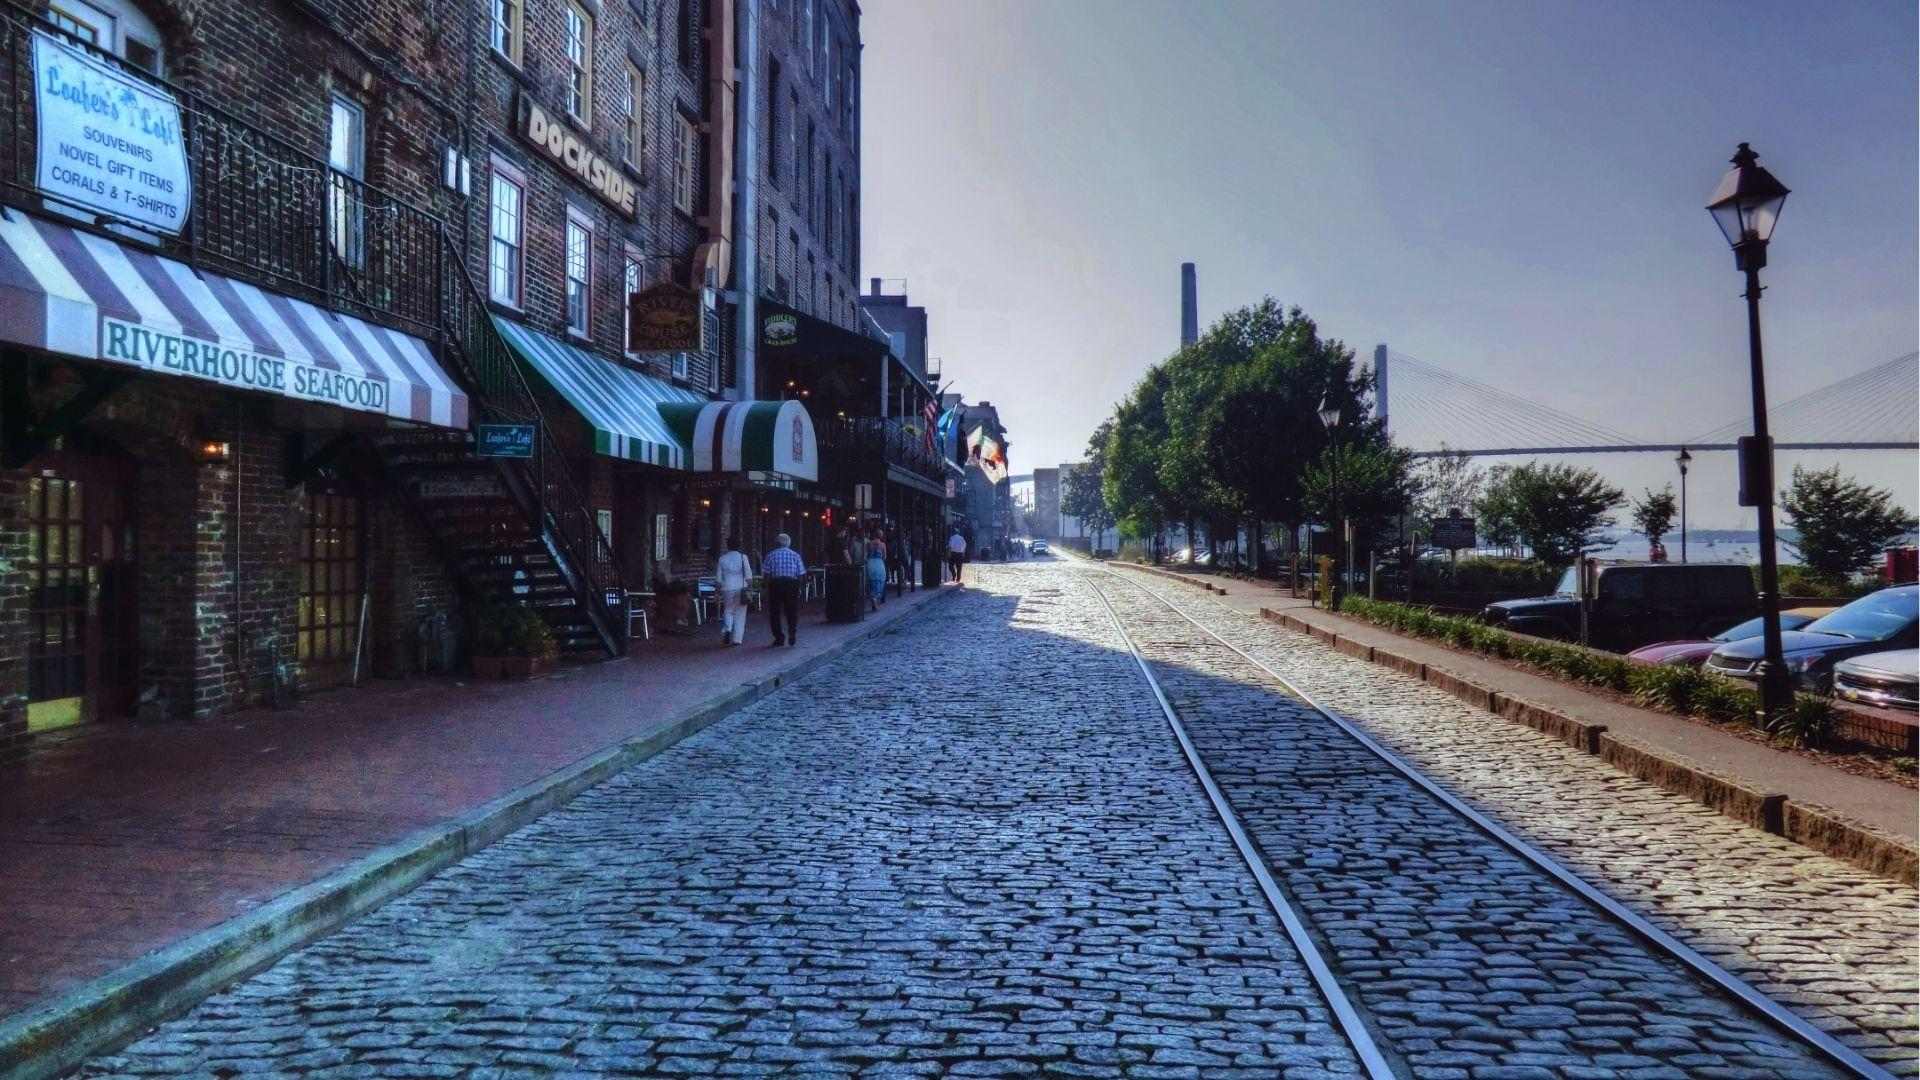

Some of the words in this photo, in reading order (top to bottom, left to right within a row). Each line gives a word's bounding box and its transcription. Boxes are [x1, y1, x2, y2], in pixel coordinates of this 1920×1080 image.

[83, 125, 153, 162] SOUVENIRS
[141, 107, 175, 146] Loft
[59, 142, 102, 169] NOVEL
[107, 159, 135, 180] GIFT
[139, 171, 174, 194] ITEMS
[529, 105, 635, 214] DOCKSIDE
[51, 165, 105, 195] CORALS
[110, 185, 118, 199] &
[124, 190, 177, 219] T-SHIRTS
[107, 320, 286, 391] RIVERHOUSE
[294, 365, 385, 408] SEAFOOD
